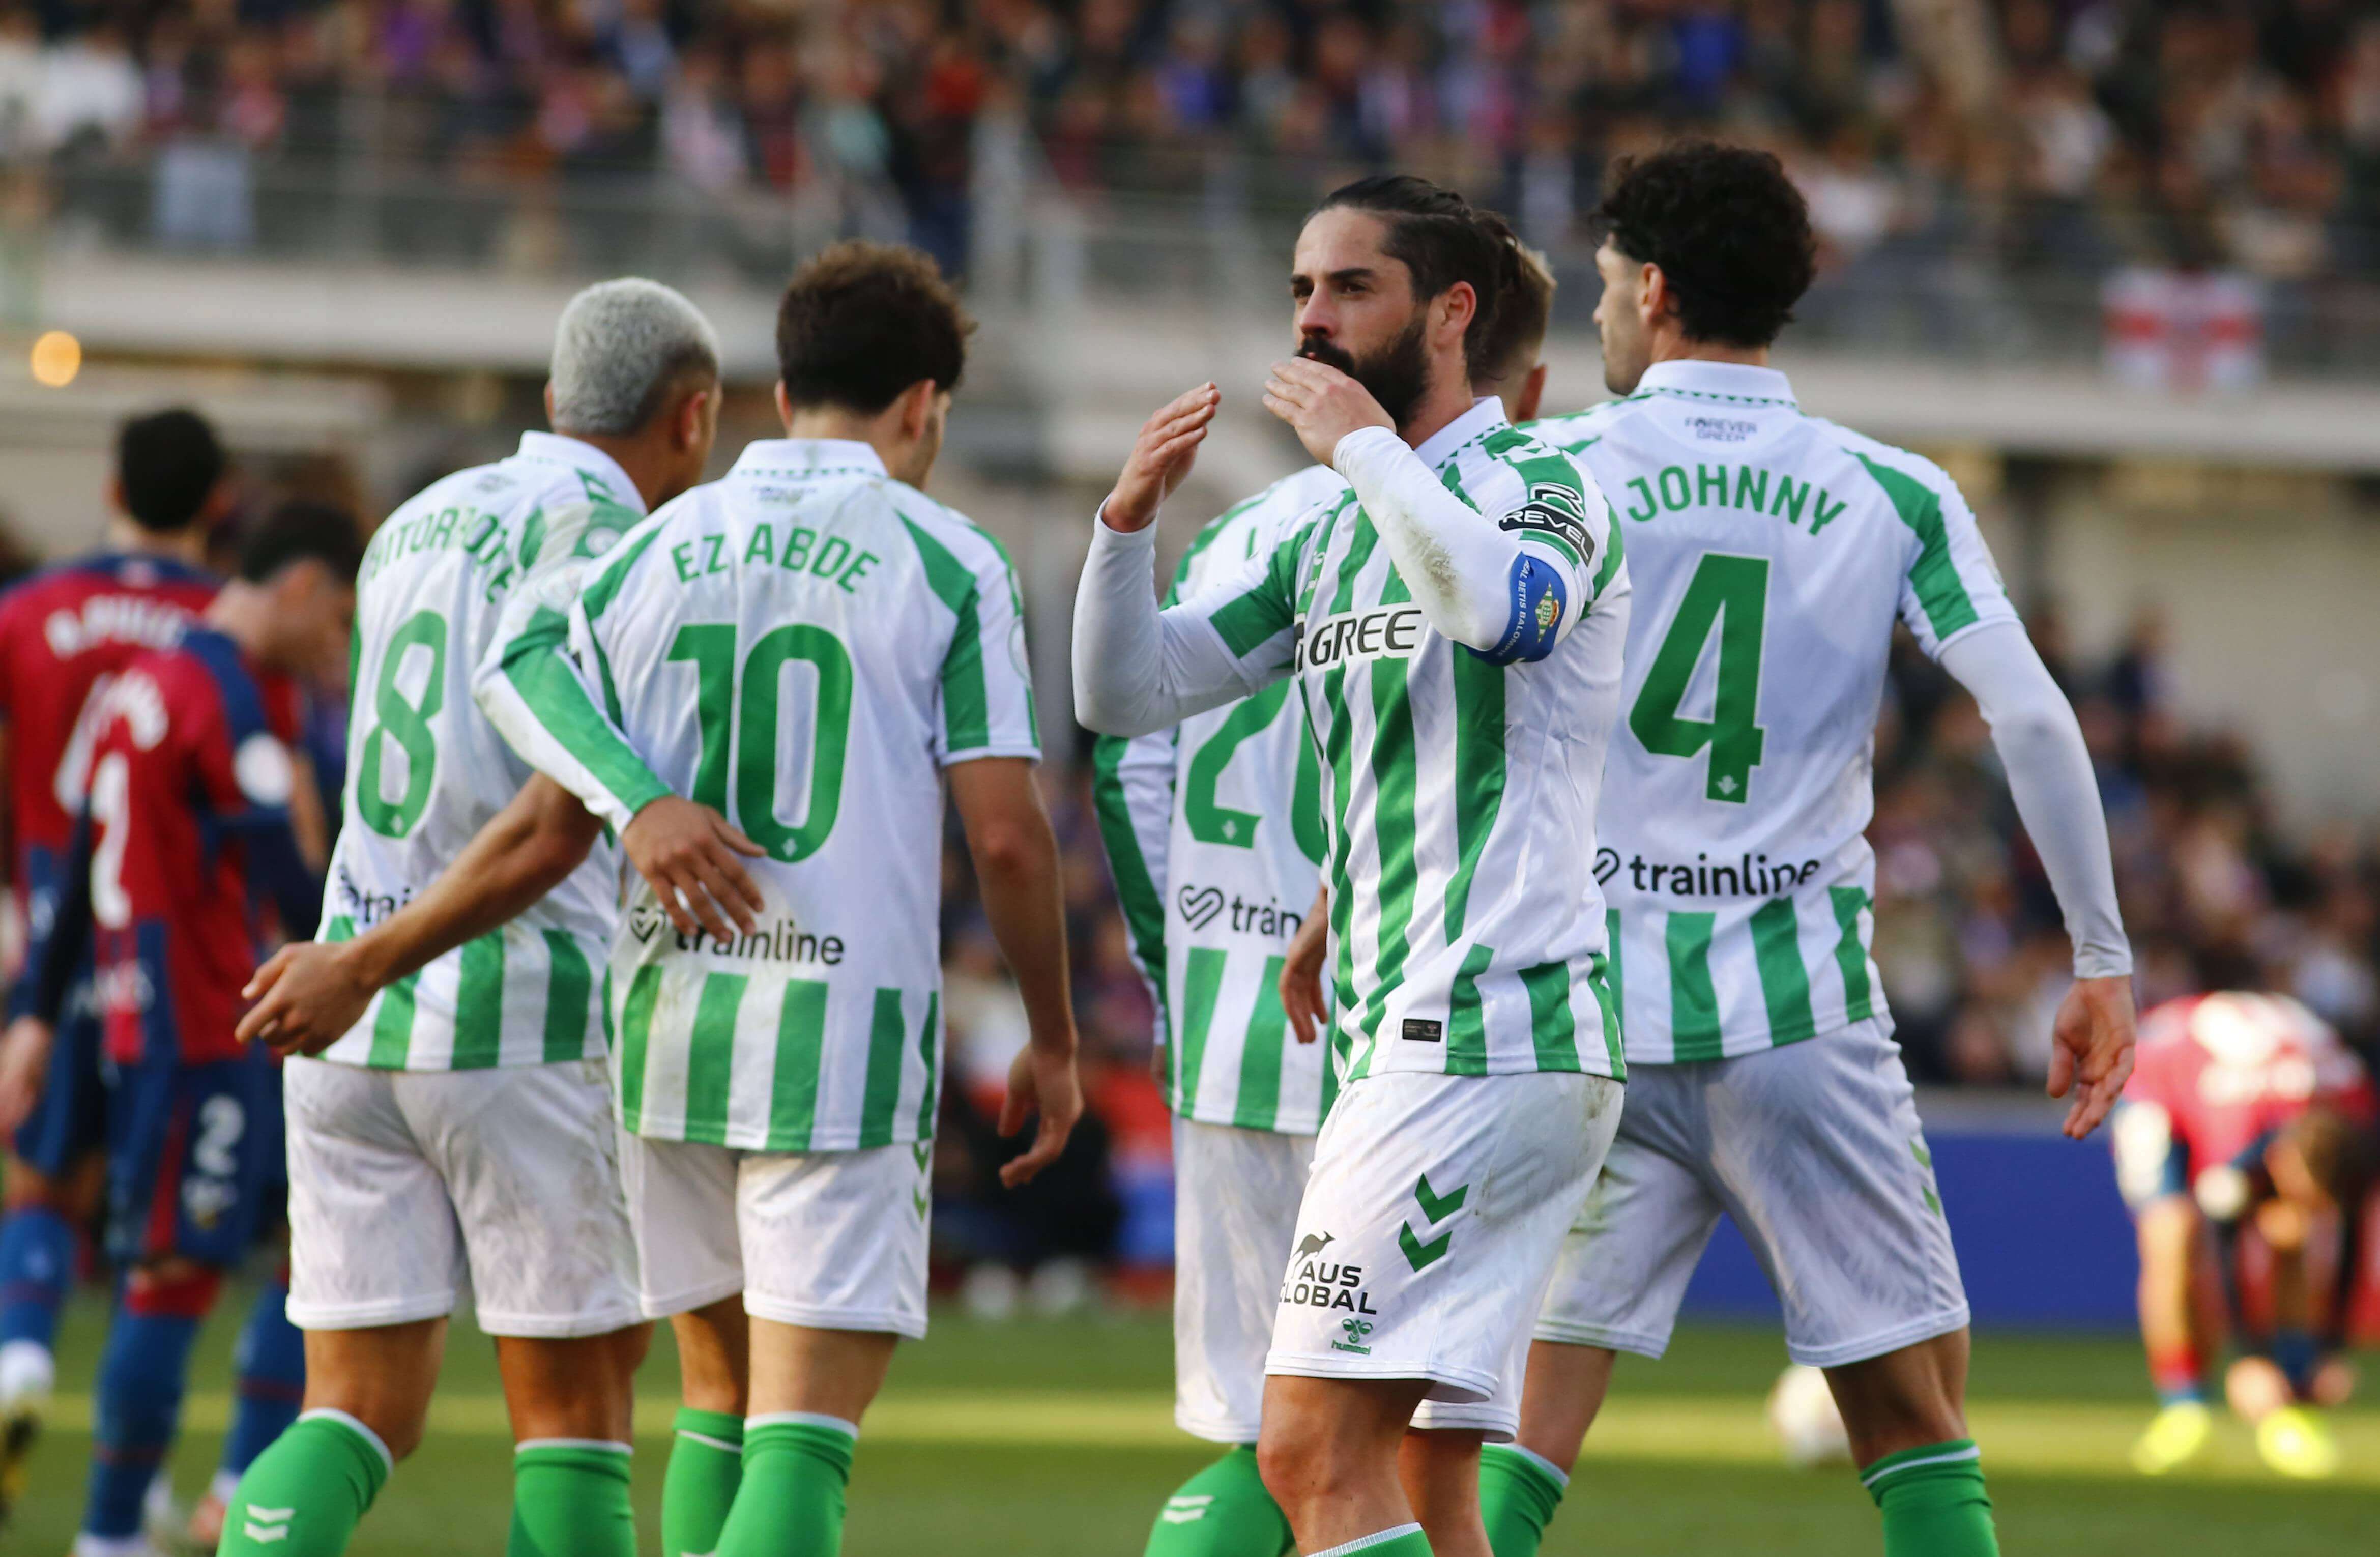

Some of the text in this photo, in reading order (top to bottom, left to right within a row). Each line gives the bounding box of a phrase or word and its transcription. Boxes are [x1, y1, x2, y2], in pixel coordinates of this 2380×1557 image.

[1626, 464, 1848, 536] JOHNNY
[671, 523, 880, 594] EZ ABDE
[1502, 509, 1589, 561] REVEL
[1518, 580, 1526, 609] BETIS
[1309, 609, 1421, 666] GREE
[1629, 551, 1770, 804] 4
[357, 610, 447, 839] 8
[666, 623, 853, 863] 10
[1629, 852, 1820, 896] trainline
[1279, 1282, 1377, 1315] LOBAL
[1299, 1261, 1362, 1288] AUS
[1331, 1339, 1372, 1356] hummel
